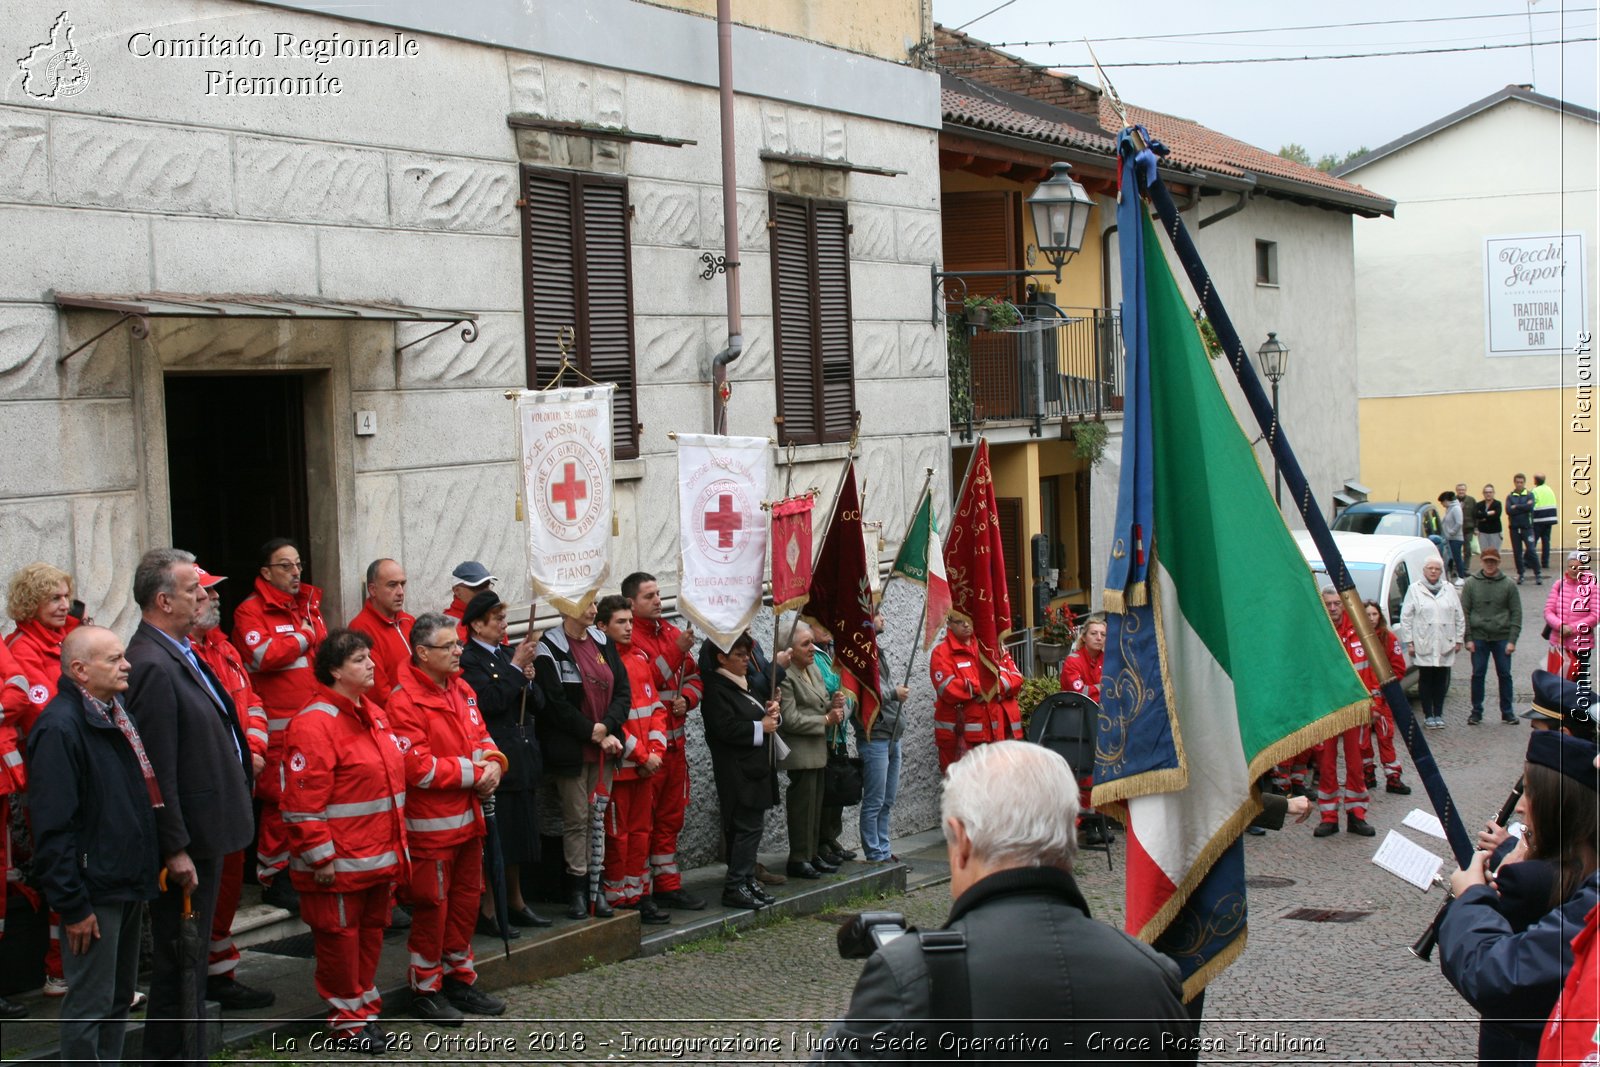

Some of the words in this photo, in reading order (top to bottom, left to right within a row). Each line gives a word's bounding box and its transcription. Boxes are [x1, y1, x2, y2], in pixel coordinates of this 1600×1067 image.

[1499, 243, 1563, 265] Vecchi
[1504, 261, 1567, 287] Sapori
[1513, 302, 1559, 317] TRATTORIA
[1518, 317, 1554, 331] PIZZERIA
[1528, 332, 1545, 346] BAR
[363, 415, 371, 429] 4
[544, 422, 577, 444] ROSSA
[557, 443, 587, 458] GINEVRA
[547, 454, 556, 466] DI
[587, 460, 597, 473] 22
[591, 475, 602, 513] AGOSTO
[577, 514, 595, 535] 1864
[557, 564, 591, 580] FIANO
[747, 575, 755, 585] DI
[842, 646, 867, 669] 1945
